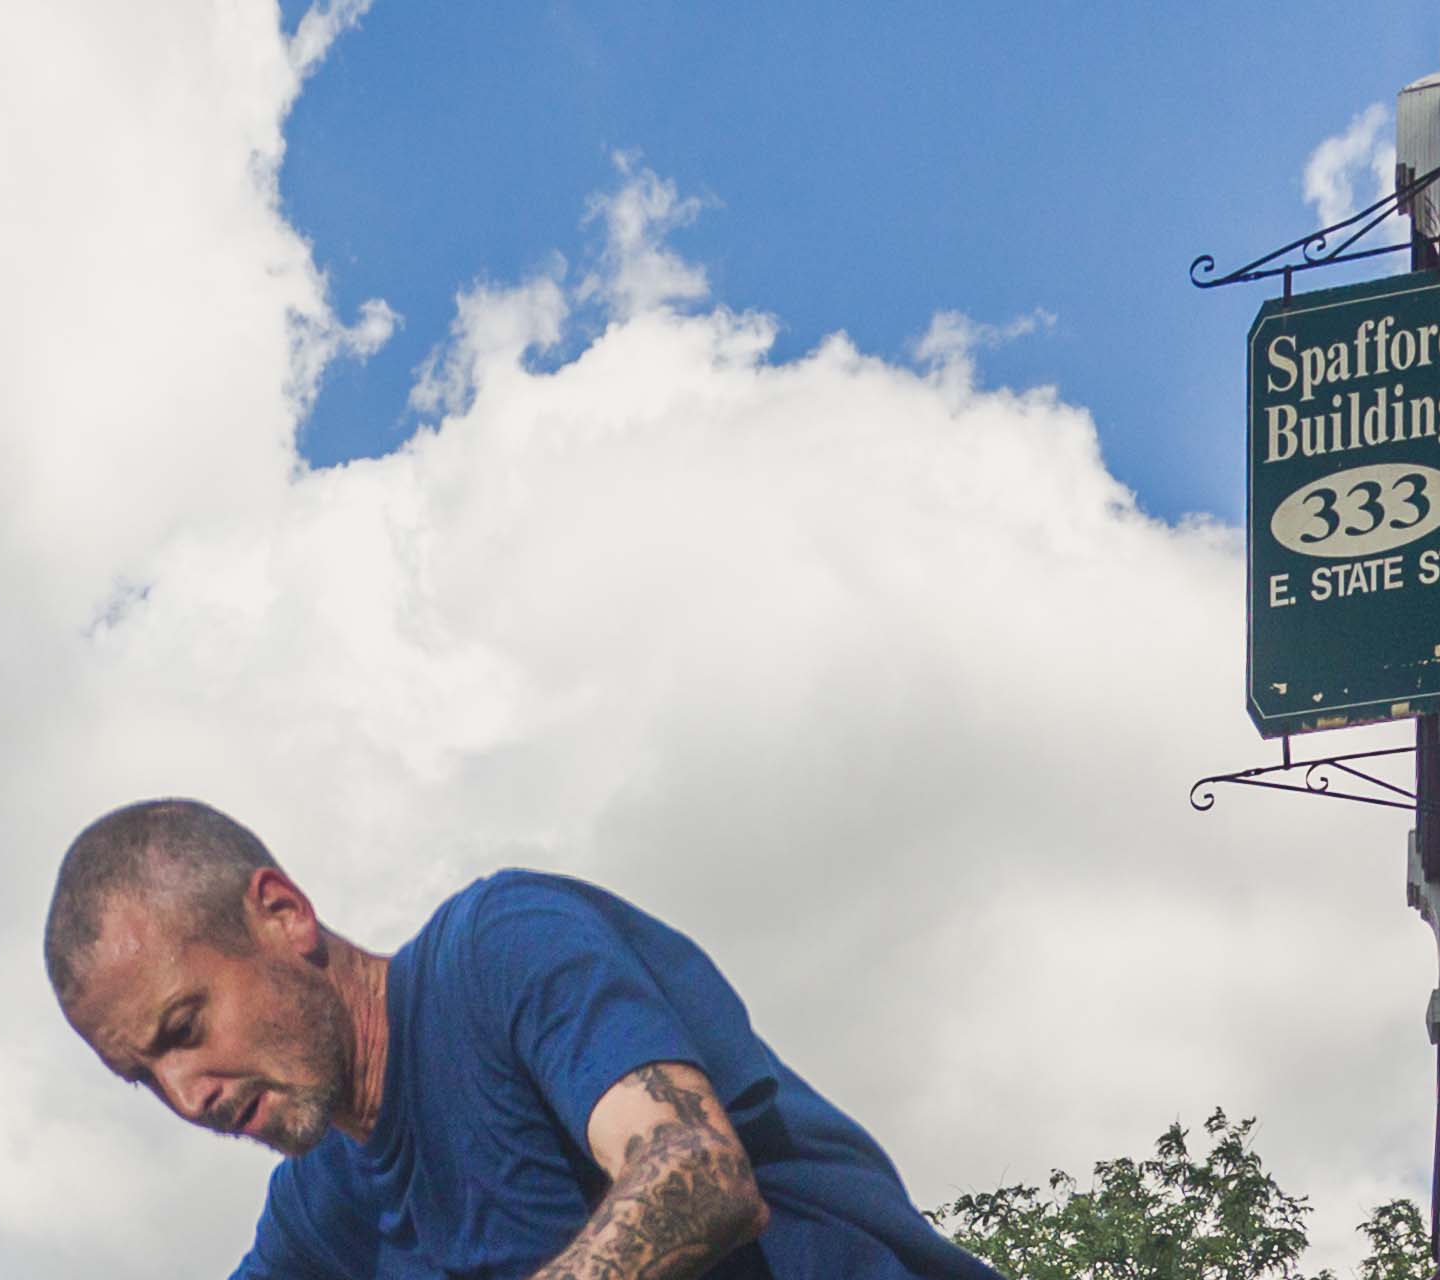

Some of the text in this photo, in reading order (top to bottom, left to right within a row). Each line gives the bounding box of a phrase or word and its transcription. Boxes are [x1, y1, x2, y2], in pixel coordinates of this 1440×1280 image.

[1300, 473, 1430, 543] 333
[1270, 573, 1296, 608] E.
[1311, 555, 1403, 601] STATE
